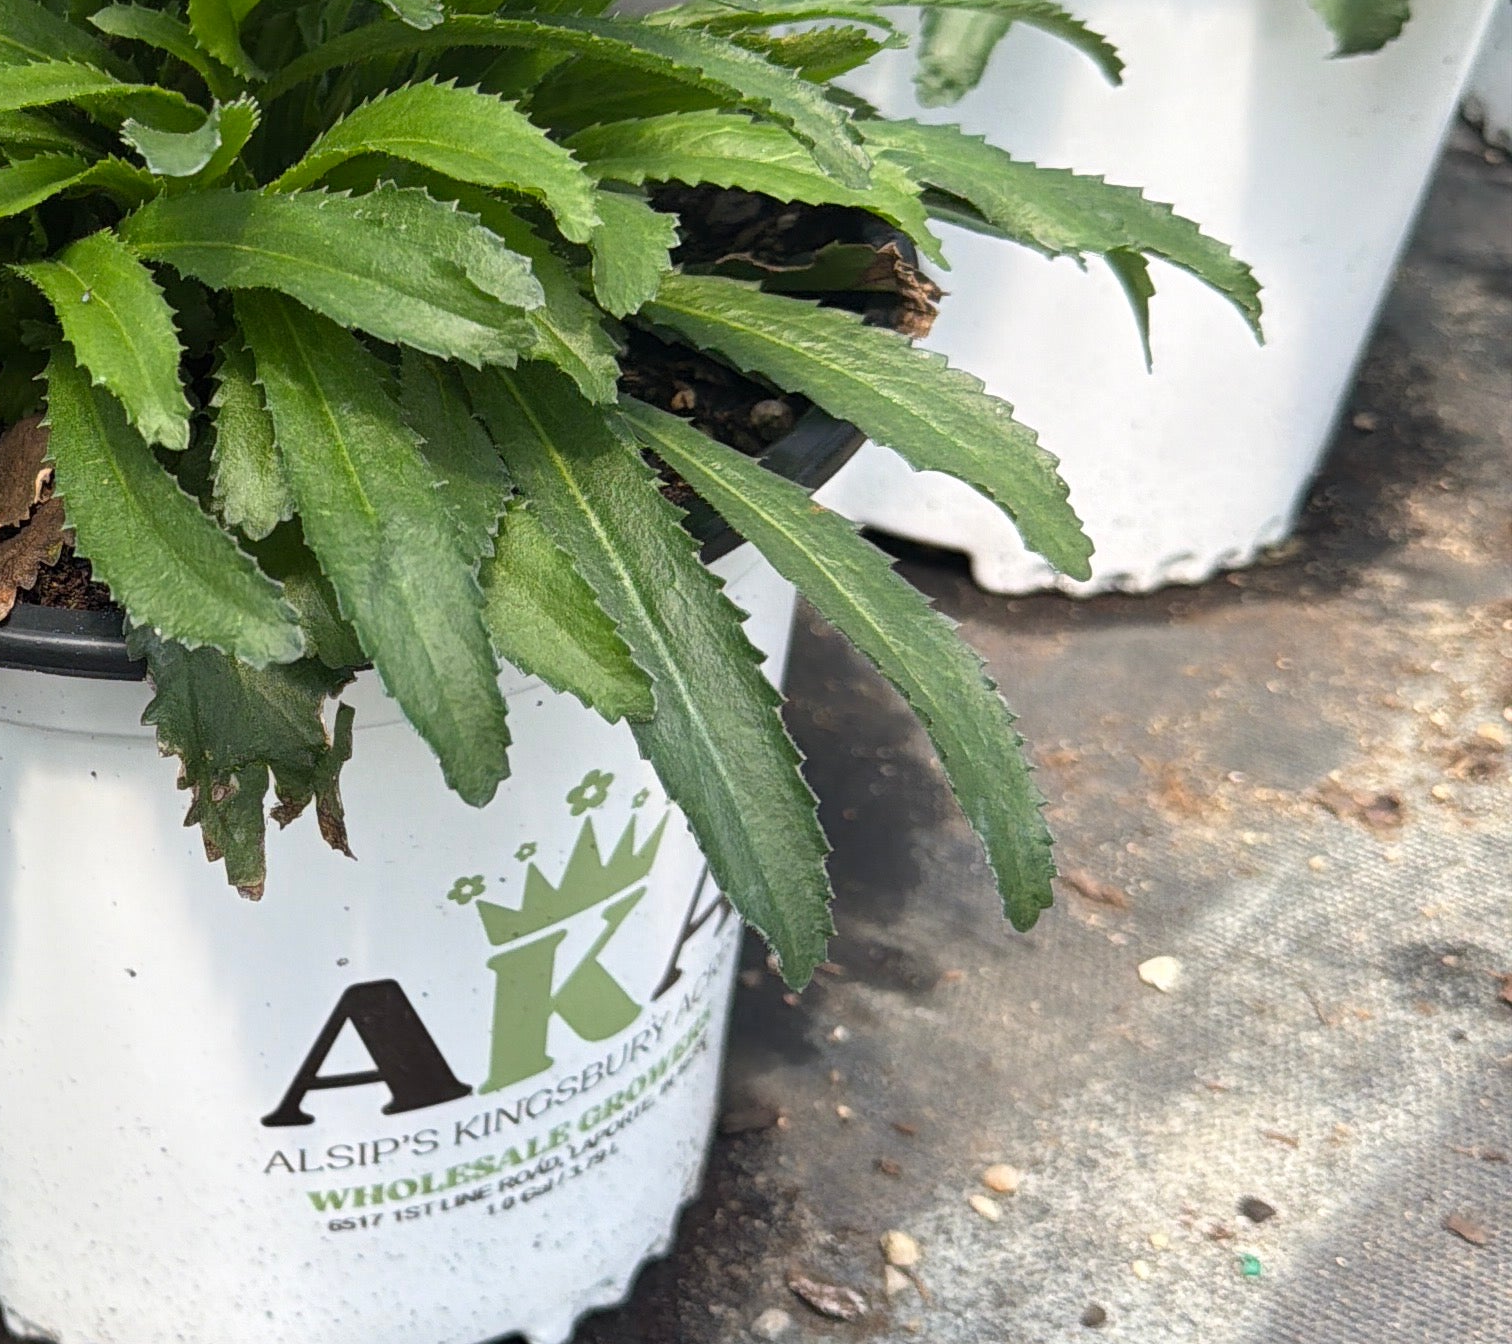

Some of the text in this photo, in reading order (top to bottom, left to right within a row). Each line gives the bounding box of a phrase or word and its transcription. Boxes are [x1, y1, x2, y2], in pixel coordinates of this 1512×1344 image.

[263, 1128, 440, 1173] ALSIP'S
[454, 1011, 671, 1146] KINGSBURY
[306, 1001, 712, 1212] WHOLESALE GROWERS
[328, 1212, 384, 1232] 6517
[393, 1200, 435, 1223] 1ST
[440, 1183, 493, 1211] LINE
